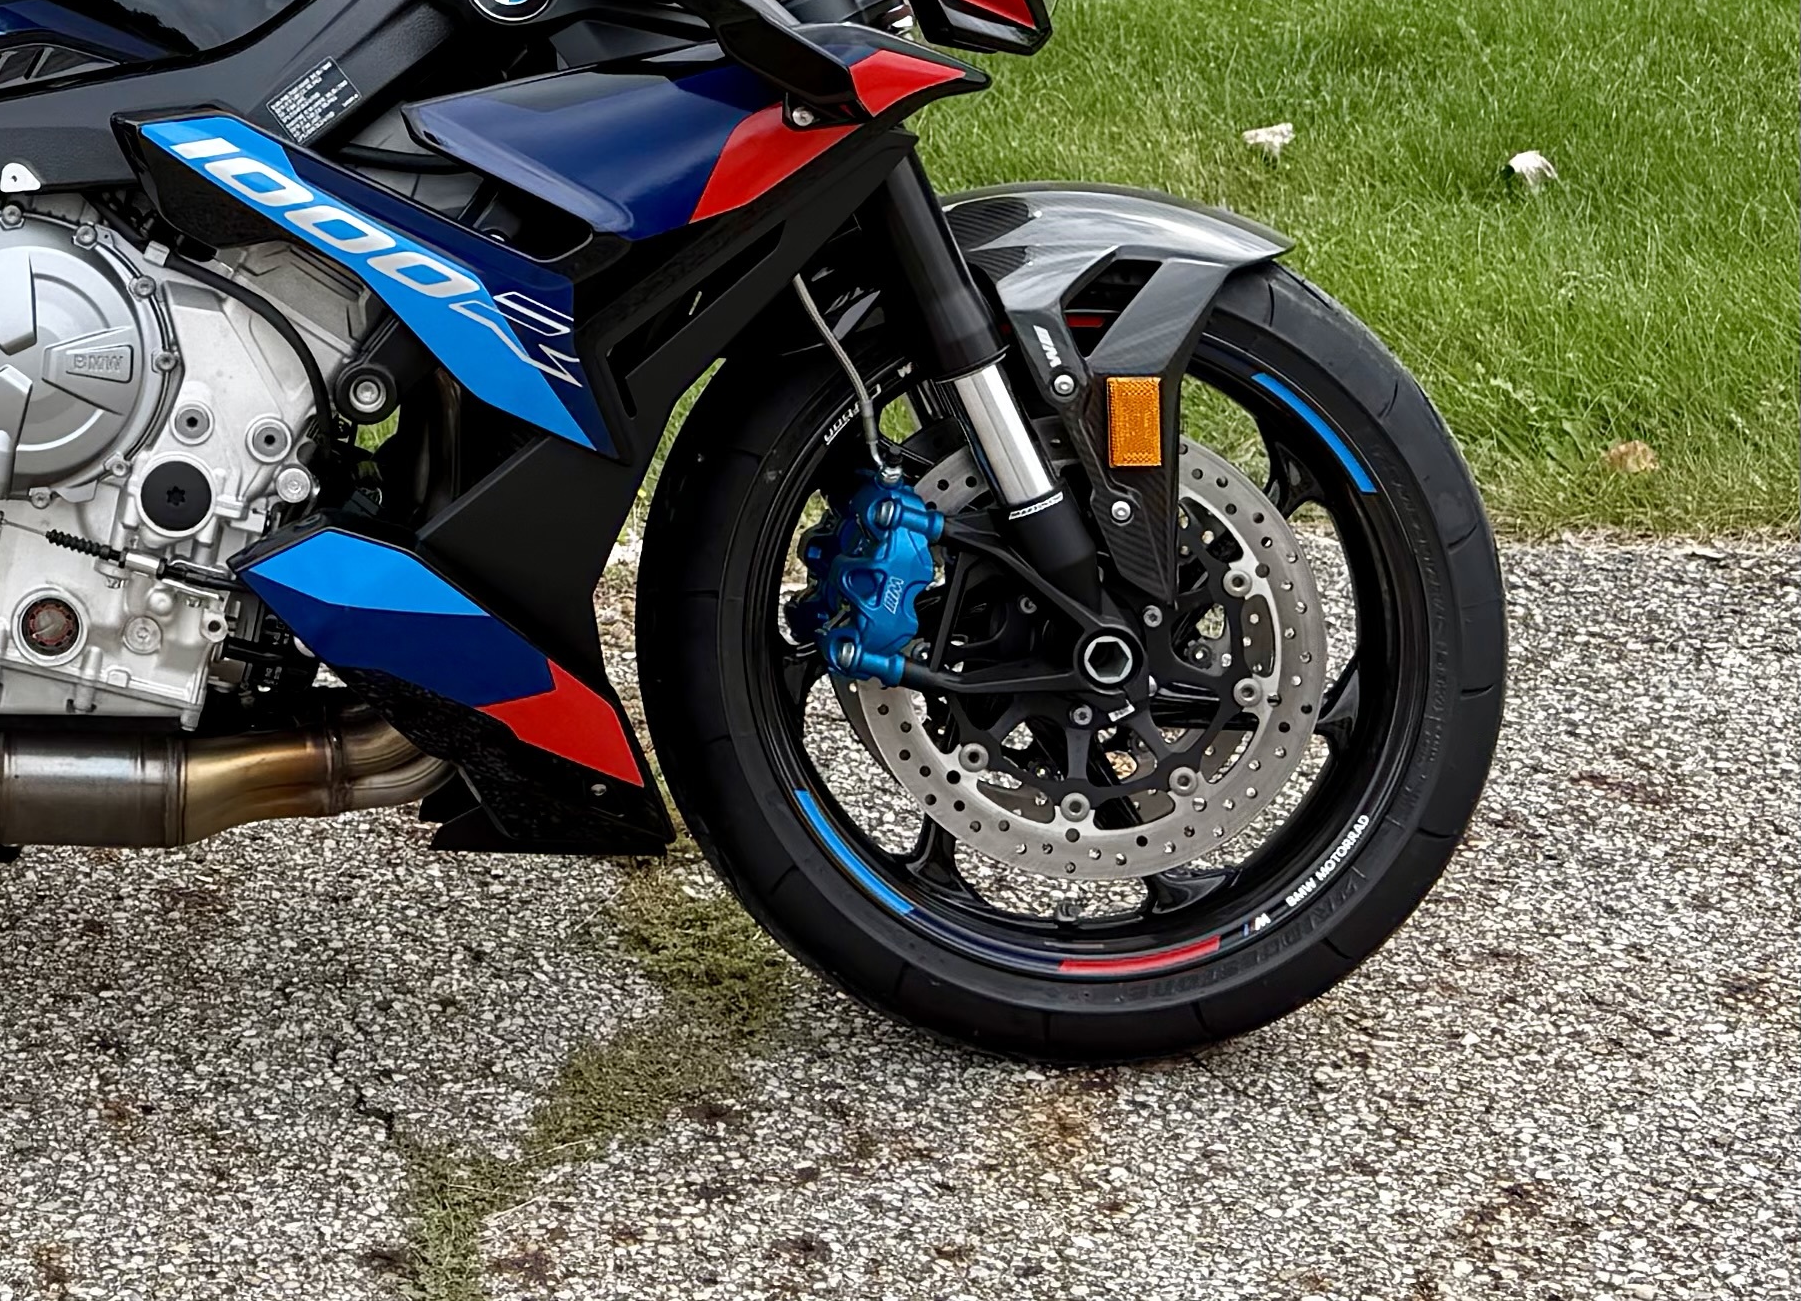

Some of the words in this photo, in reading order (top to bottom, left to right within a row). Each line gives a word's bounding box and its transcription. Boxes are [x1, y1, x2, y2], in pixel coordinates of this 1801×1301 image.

[170, 138, 481, 298] 1000
[73, 354, 124, 371] BMW
[1285, 877, 1316, 907] BMW
[1315, 814, 1370, 881] MOTORRAD
